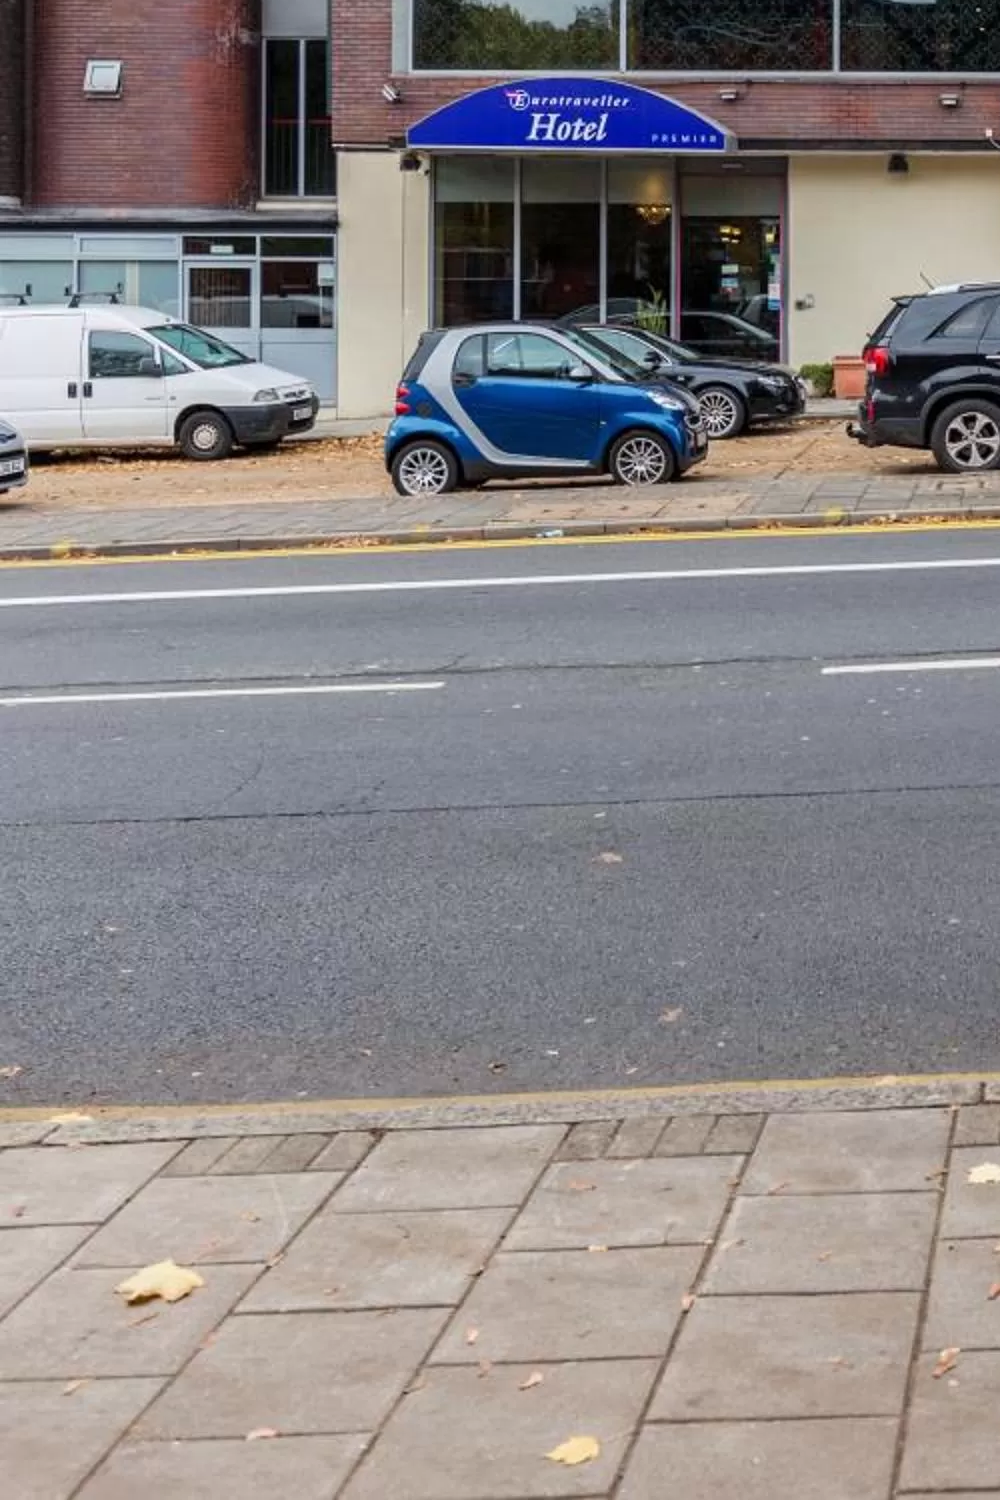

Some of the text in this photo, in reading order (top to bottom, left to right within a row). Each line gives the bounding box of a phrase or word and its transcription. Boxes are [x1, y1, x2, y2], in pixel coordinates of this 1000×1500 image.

[513, 90, 631, 109] Eurotraveller
[525, 113, 608, 142] Hotel
[651, 133, 718, 144] PREMIER
